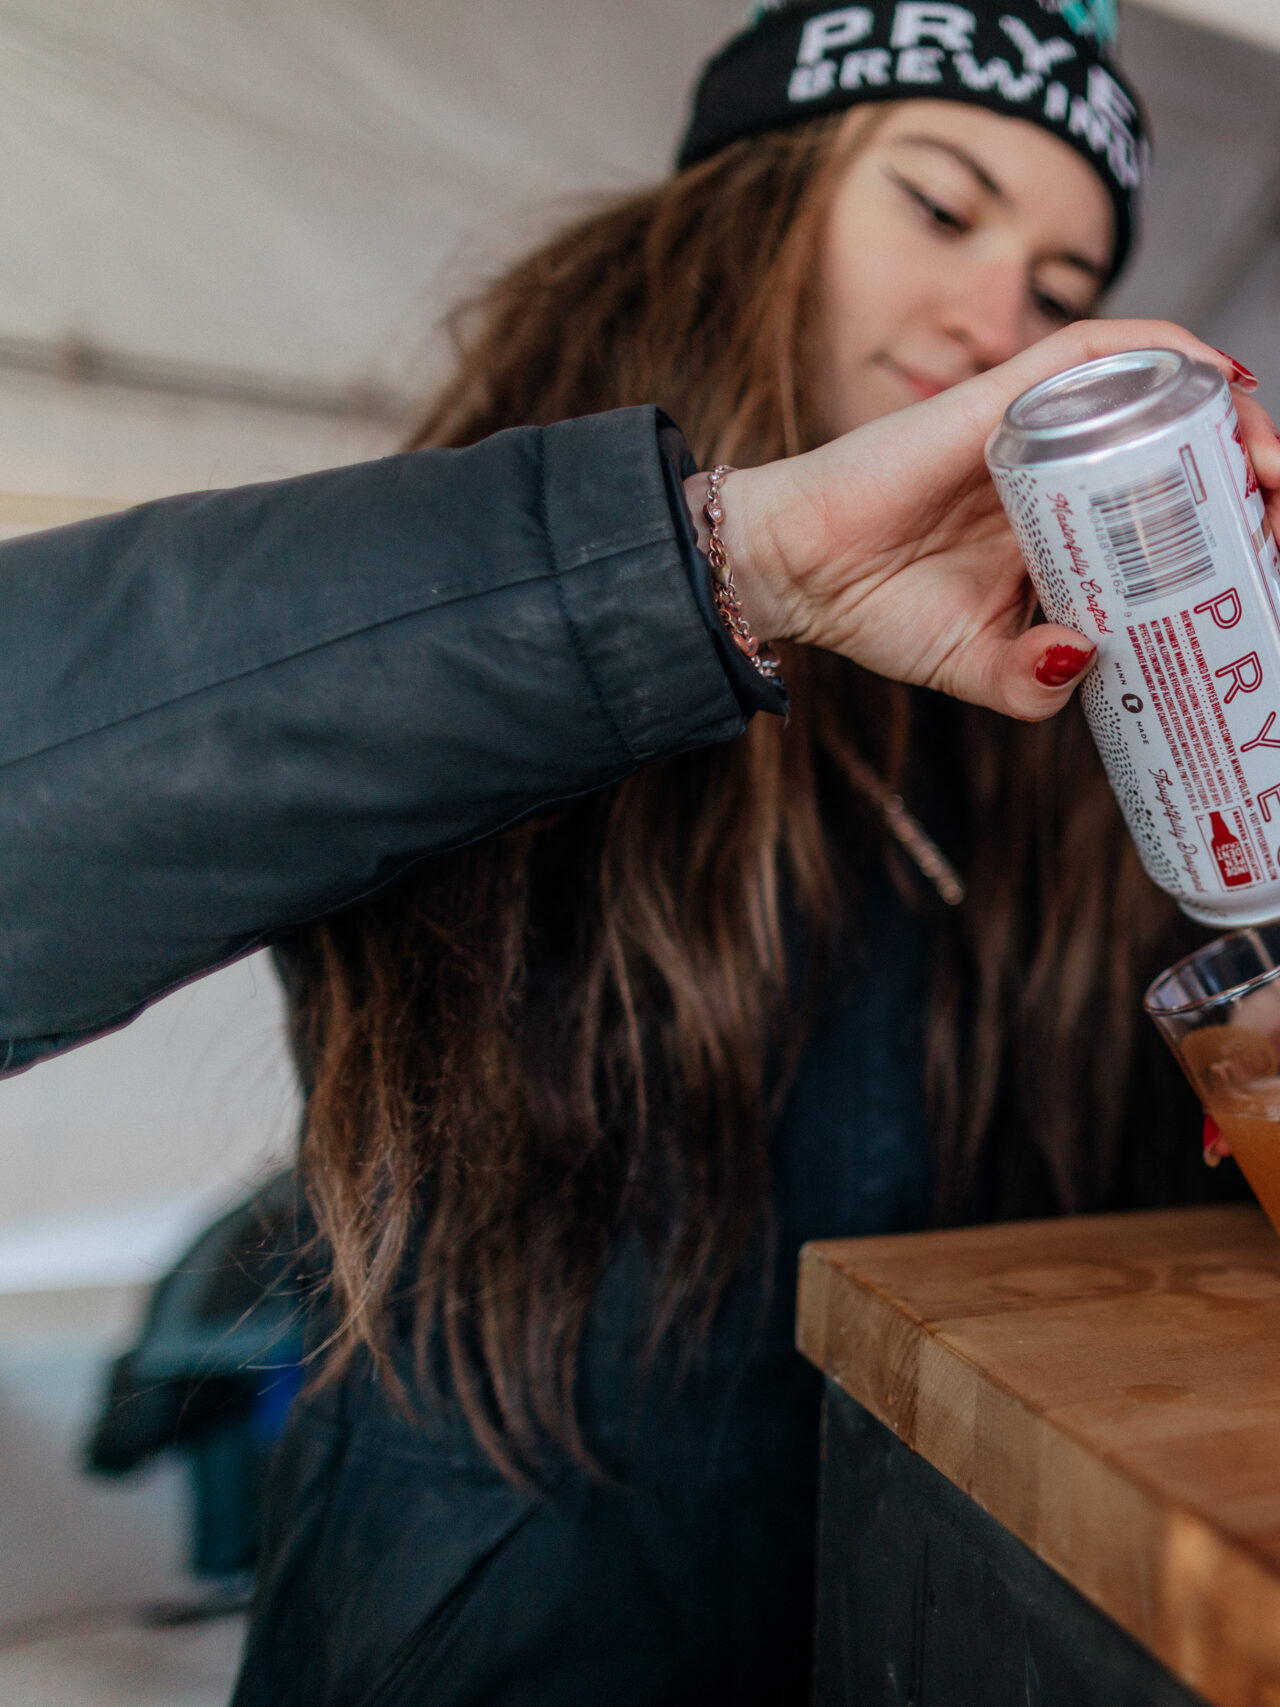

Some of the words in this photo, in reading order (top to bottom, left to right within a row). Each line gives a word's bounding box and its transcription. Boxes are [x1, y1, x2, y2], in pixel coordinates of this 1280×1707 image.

[797, 1, 1137, 146] PRYE
[1045, 492, 1090, 578] Masterfully
[1079, 577, 1114, 634] Crafted
[1102, 551, 1126, 596] 00162
[1112, 661, 1127, 685] MINN
[1135, 720, 1149, 744] MADE
[1178, 608, 1196, 637] BREWED
[1192, 648, 1209, 675] CANNED
[1210, 700, 1228, 730] BREWING
[1148, 767, 1188, 840] Thoughtfully
